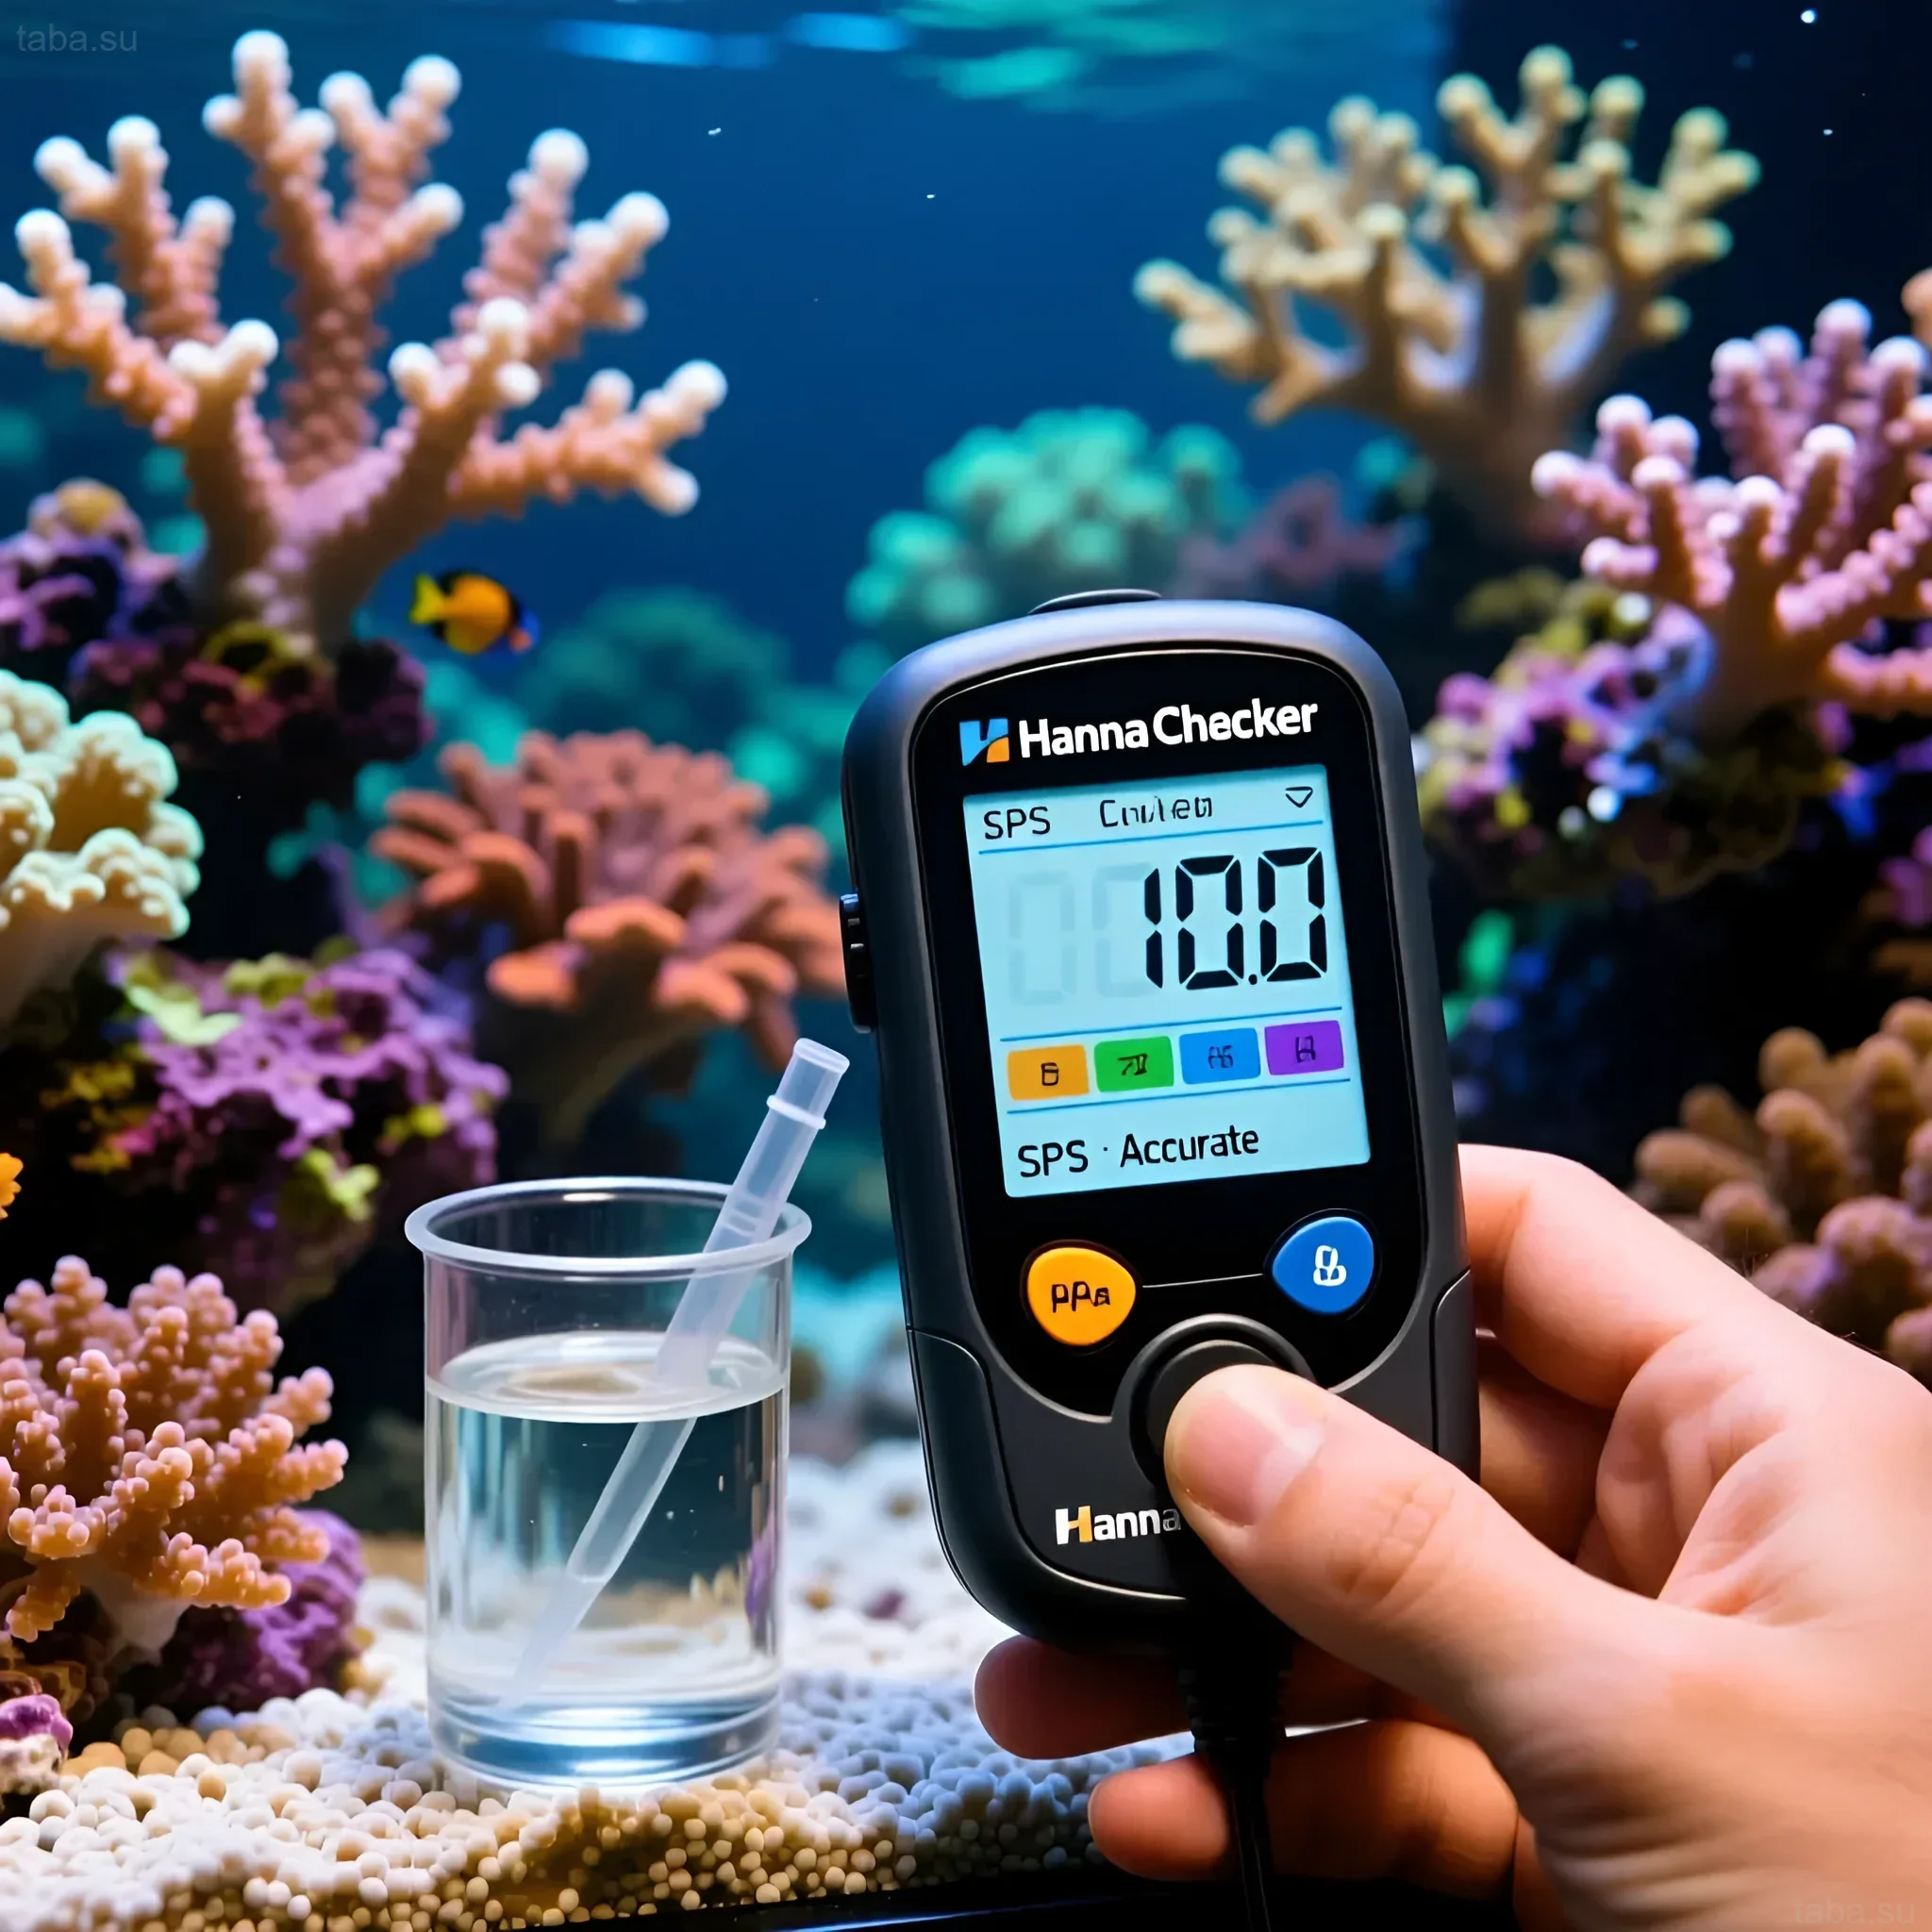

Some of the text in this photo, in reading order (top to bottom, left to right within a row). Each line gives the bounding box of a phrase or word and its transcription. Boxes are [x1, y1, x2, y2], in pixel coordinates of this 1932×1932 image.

[1019, 698, 1319, 758] Hanna Checker
[983, 806, 1051, 840] SPS
[1144, 847, 1328, 991] 10.0
[1018, 1124, 1259, 1177] SPS Accurate
[1055, 1506, 1181, 1545] Hanna
